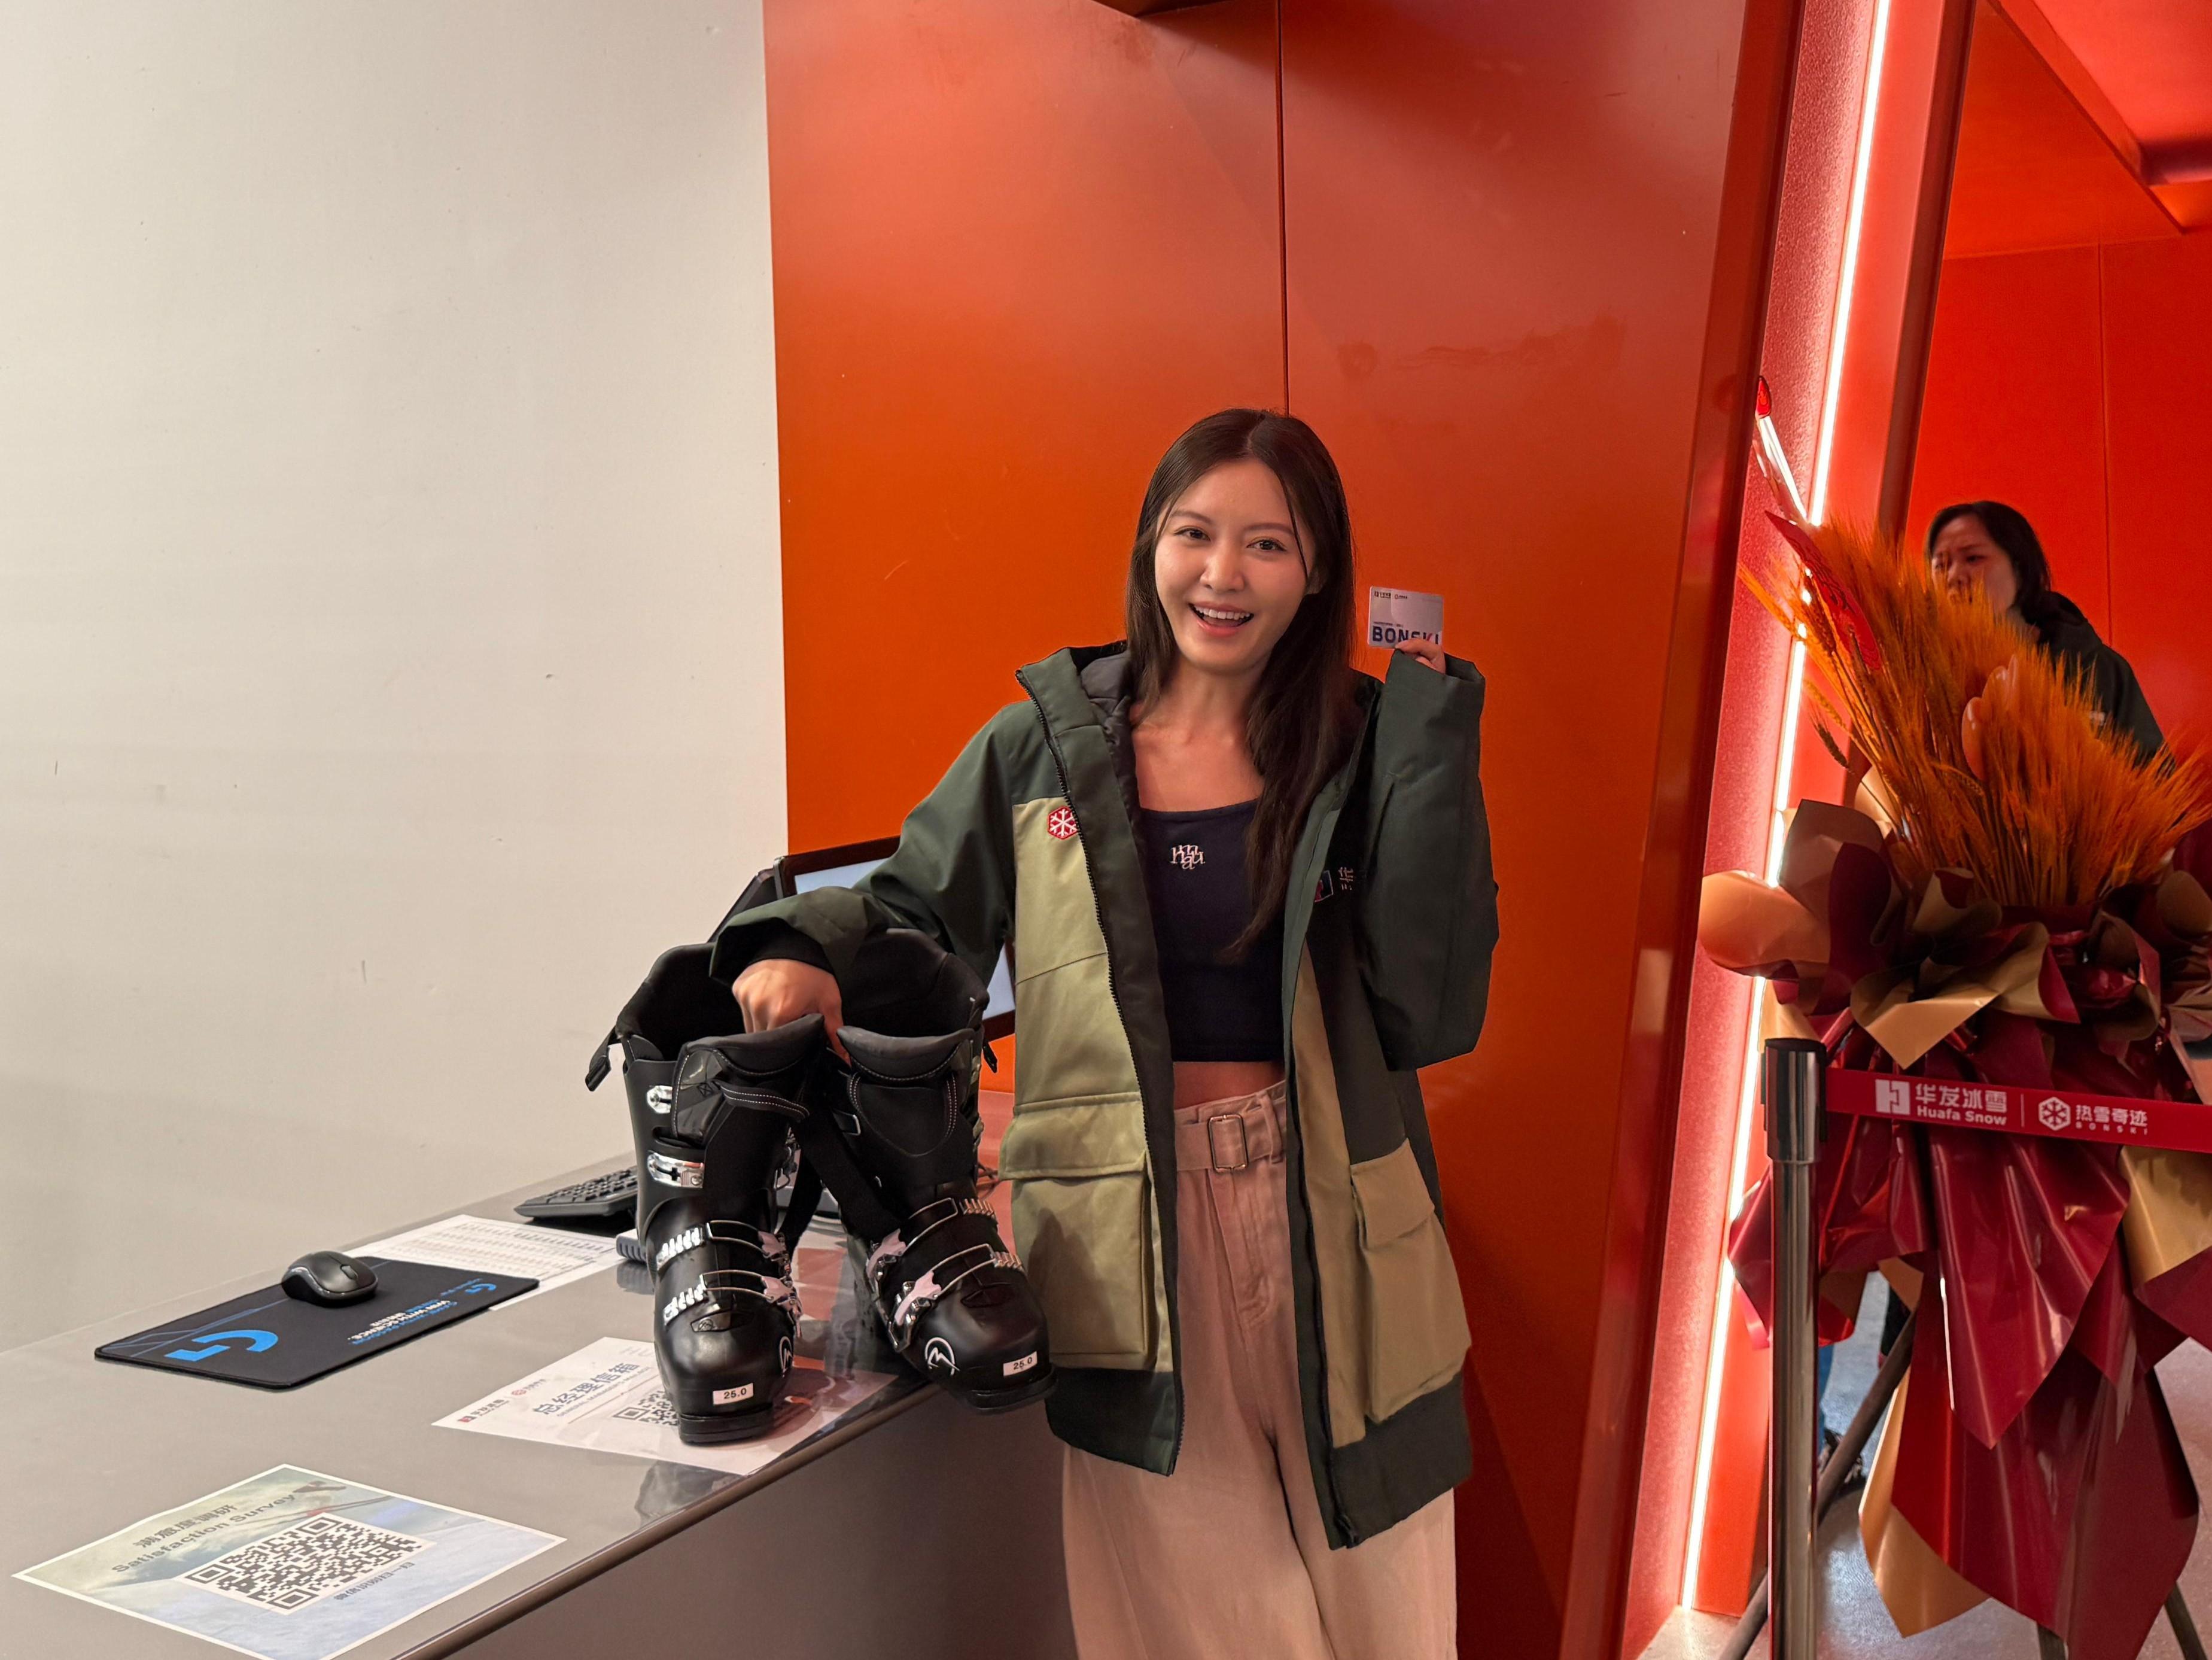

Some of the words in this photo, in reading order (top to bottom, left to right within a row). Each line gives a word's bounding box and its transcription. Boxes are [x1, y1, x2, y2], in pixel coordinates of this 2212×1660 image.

[1915, 1083, 2007, 1114] 华发冰雪
[1916, 1105, 1961, 1121] Huafa
[1965, 1111, 2007, 1126] Snow
[2076, 1104, 2148, 1127] 热雪奇迹
[532, 1363, 640, 1415] 总经理信箱
[723, 1388, 747, 1399] 25.0
[111, 1521, 232, 1573] Satisfaction
[229, 1494, 297, 1522] Survey
[133, 1504, 240, 1548] 满意度调研
